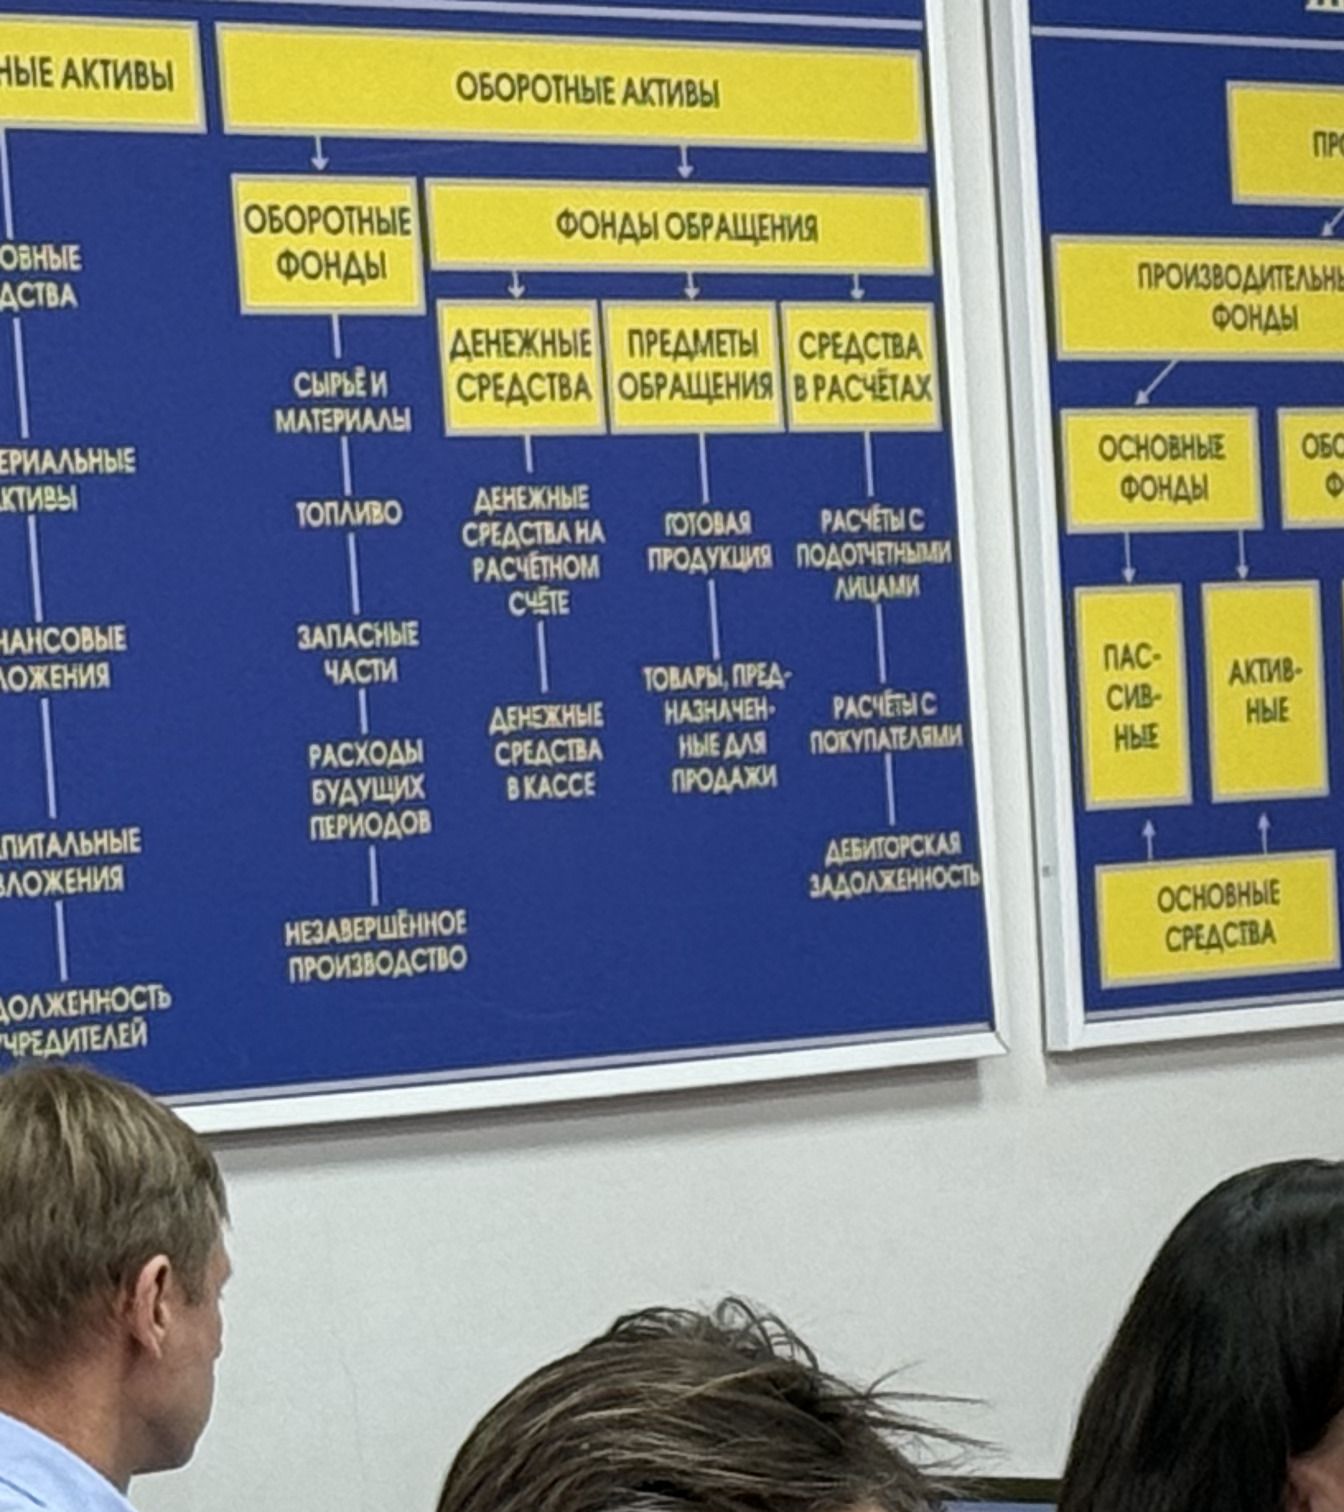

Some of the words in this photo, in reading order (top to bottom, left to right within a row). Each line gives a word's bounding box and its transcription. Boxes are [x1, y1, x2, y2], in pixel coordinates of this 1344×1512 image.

[61, 57, 174, 92] АКТИВЫ
[455, 70, 615, 107] ОБОРОТНЫЕ
[622, 78, 720, 109] АКТИВЫ
[244, 204, 412, 237] ОБОРОТНЫЕ
[557, 208, 659, 243] ФОНДЫ
[665, 213, 818, 248] ОБРАЩЕНИЯ
[277, 250, 387, 284] ФОНДЫ
[1212, 303, 1299, 334] ФОНДЫ
[449, 328, 592, 362] ДЕНЕЖНЫЕ
[628, 328, 758, 361] ПРЕДМЕТЫ
[799, 330, 922, 364] СРЕДСТВА
[294, 366, 367, 398] СЫРЬЁ
[371, 371, 387, 396] И
[455, 371, 592, 406] СРЕДСТВА
[618, 370, 774, 406] ОБРАЩЕНИЯ
[794, 372, 807, 400] В
[812, 367, 932, 403] РАСЧЁТАХ
[275, 406, 412, 433] МАТЕРИАЛЫ
[1099, 432, 1225, 463] ОСНОВНЫЕ
[0, 484, 78, 512] КТИВЫ
[474, 485, 590, 512] ДЕНЕЖНЫЕ
[1121, 474, 1208, 503] ФОНДЫ
[296, 499, 403, 527] ТОПЛИВО
[665, 509, 752, 537] ГОТОВАЯ
[821, 502, 906, 532] РАСЧЁТЫ
[909, 508, 926, 531] С
[462, 520, 570, 549] СРЕДСТВА
[575, 520, 606, 544] НА
[472, 549, 599, 582] РАСЧЁТНОМ
[648, 545, 773, 573] ПРОДУКЦИЯ
[508, 586, 570, 616] СЧЁТЕ
[834, 575, 920, 601] ЛИЦАМИ
[298, 621, 419, 651] ЗАПАСНЫЕ
[325, 658, 398, 685] ЧАСТИ
[1104, 642, 1161, 671] ПАС-
[1229, 657, 1303, 686] АКТИВ-
[643, 665, 728, 692] ТОВАРЫ,
[732, 662, 793, 689] ПРЕД-
[664, 698, 776, 724] НАЗНАЧЕН-
[833, 688, 918, 719] РАСЧЁТЫ
[922, 692, 937, 715] С
[1106, 682, 1162, 710] СИВ-
[1246, 697, 1289, 724] НЫЕ
[489, 702, 604, 735] ДЕНЕЖНЫЕ
[679, 733, 719, 758] НЫЕ
[724, 731, 766, 757] ДЛЯ
[810, 725, 963, 755] ПОКУПАТЕЛЯМИ
[1115, 723, 1159, 751] НЫЕ
[308, 739, 424, 769] РАСХОДЫ
[495, 739, 603, 767] СРЕДСТВА
[312, 774, 426, 807] БУДУЩИХ
[507, 774, 520, 801] В
[524, 772, 597, 799] КАССЕ
[672, 765, 778, 793] ПРОДАЖИ
[310, 809, 432, 842] ПЕРИОДОВ
[0, 826, 141, 860] ПИТАЛЬНЫЕ
[824, 832, 961, 866] ДЕБИТОРСКАЯ
[809, 864, 981, 898] ЗАДОЛЖЕННОСТЬ
[1158, 878, 1280, 912] ОСНОВНЫЕ
[285, 908, 467, 947] НЕЗАВЕРШЁННОЕ
[1166, 919, 1276, 954] СРЕДСТВА
[289, 944, 468, 983] ПРОИЗВОДСТВО
